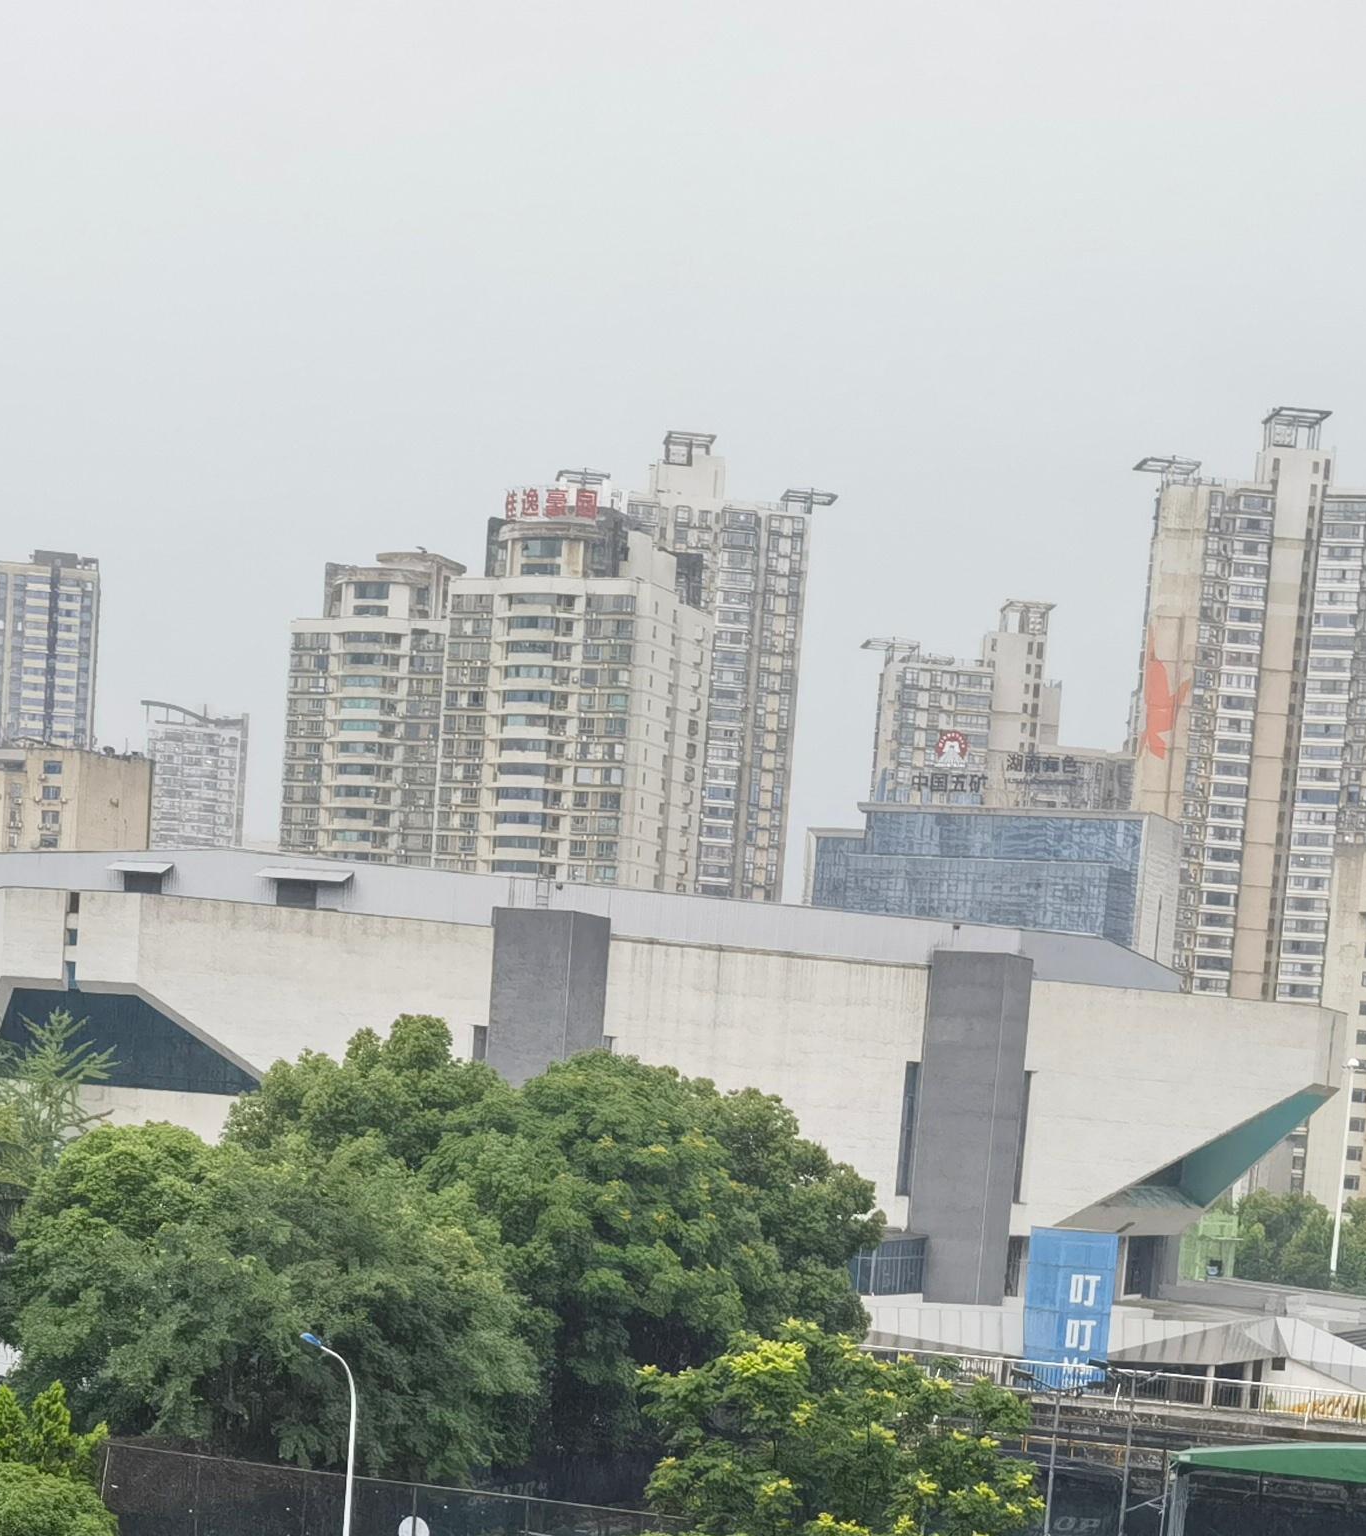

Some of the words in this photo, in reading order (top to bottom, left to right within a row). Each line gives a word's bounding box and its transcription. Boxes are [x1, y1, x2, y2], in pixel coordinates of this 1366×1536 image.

[1006, 753, 1078, 774] 湖南有色
[912, 772, 988, 793] 中国五矿
